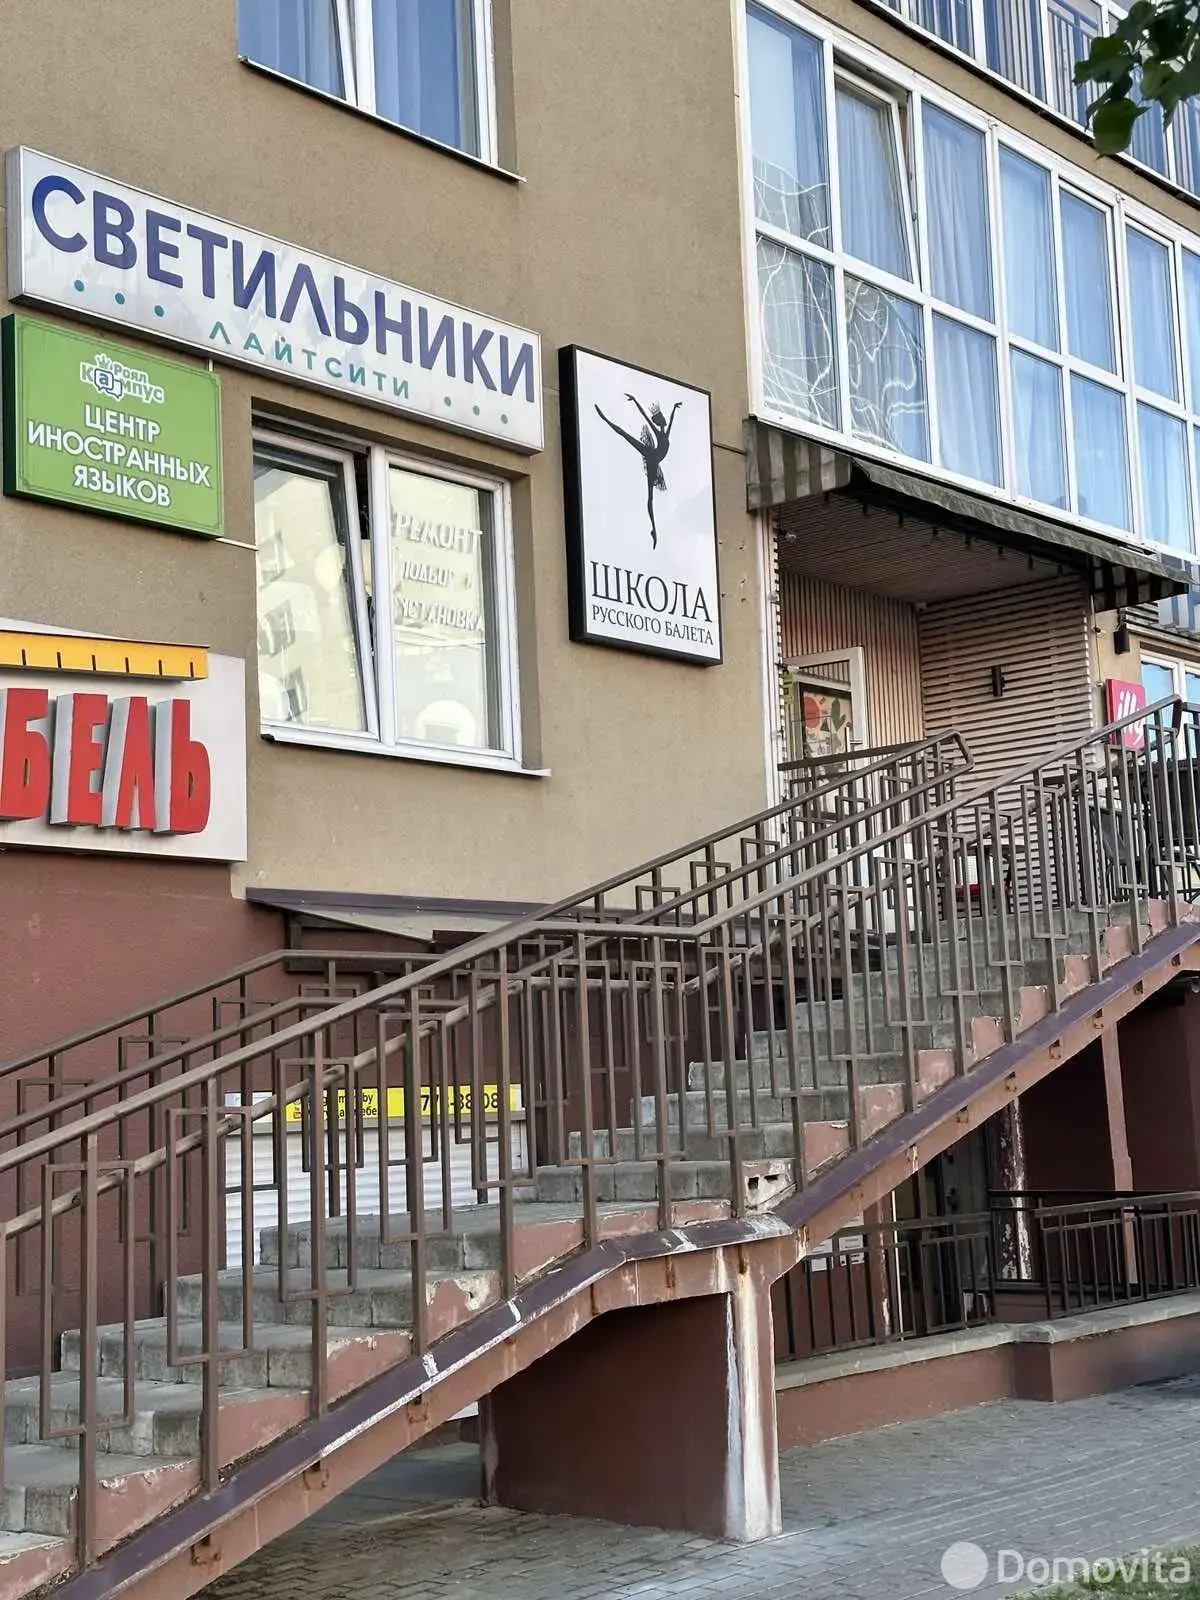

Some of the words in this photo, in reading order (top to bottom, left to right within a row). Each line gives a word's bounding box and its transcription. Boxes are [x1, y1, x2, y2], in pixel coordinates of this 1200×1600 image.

[32, 175, 535, 404] СВЕТИЛЬНИКИ
[209, 321, 410, 401] ЛАЙТСИТИ
[28, 420, 210, 487] ИНОСТРАННЫХ
[85, 404, 161, 443] ЦЕНТР
[73, 464, 171, 507] ЯЗЫКОВ
[590, 560, 713, 623] ШКОЛА
[592, 604, 661, 633] РУССКОГО
[665, 621, 713, 645] БАЛЕТА
